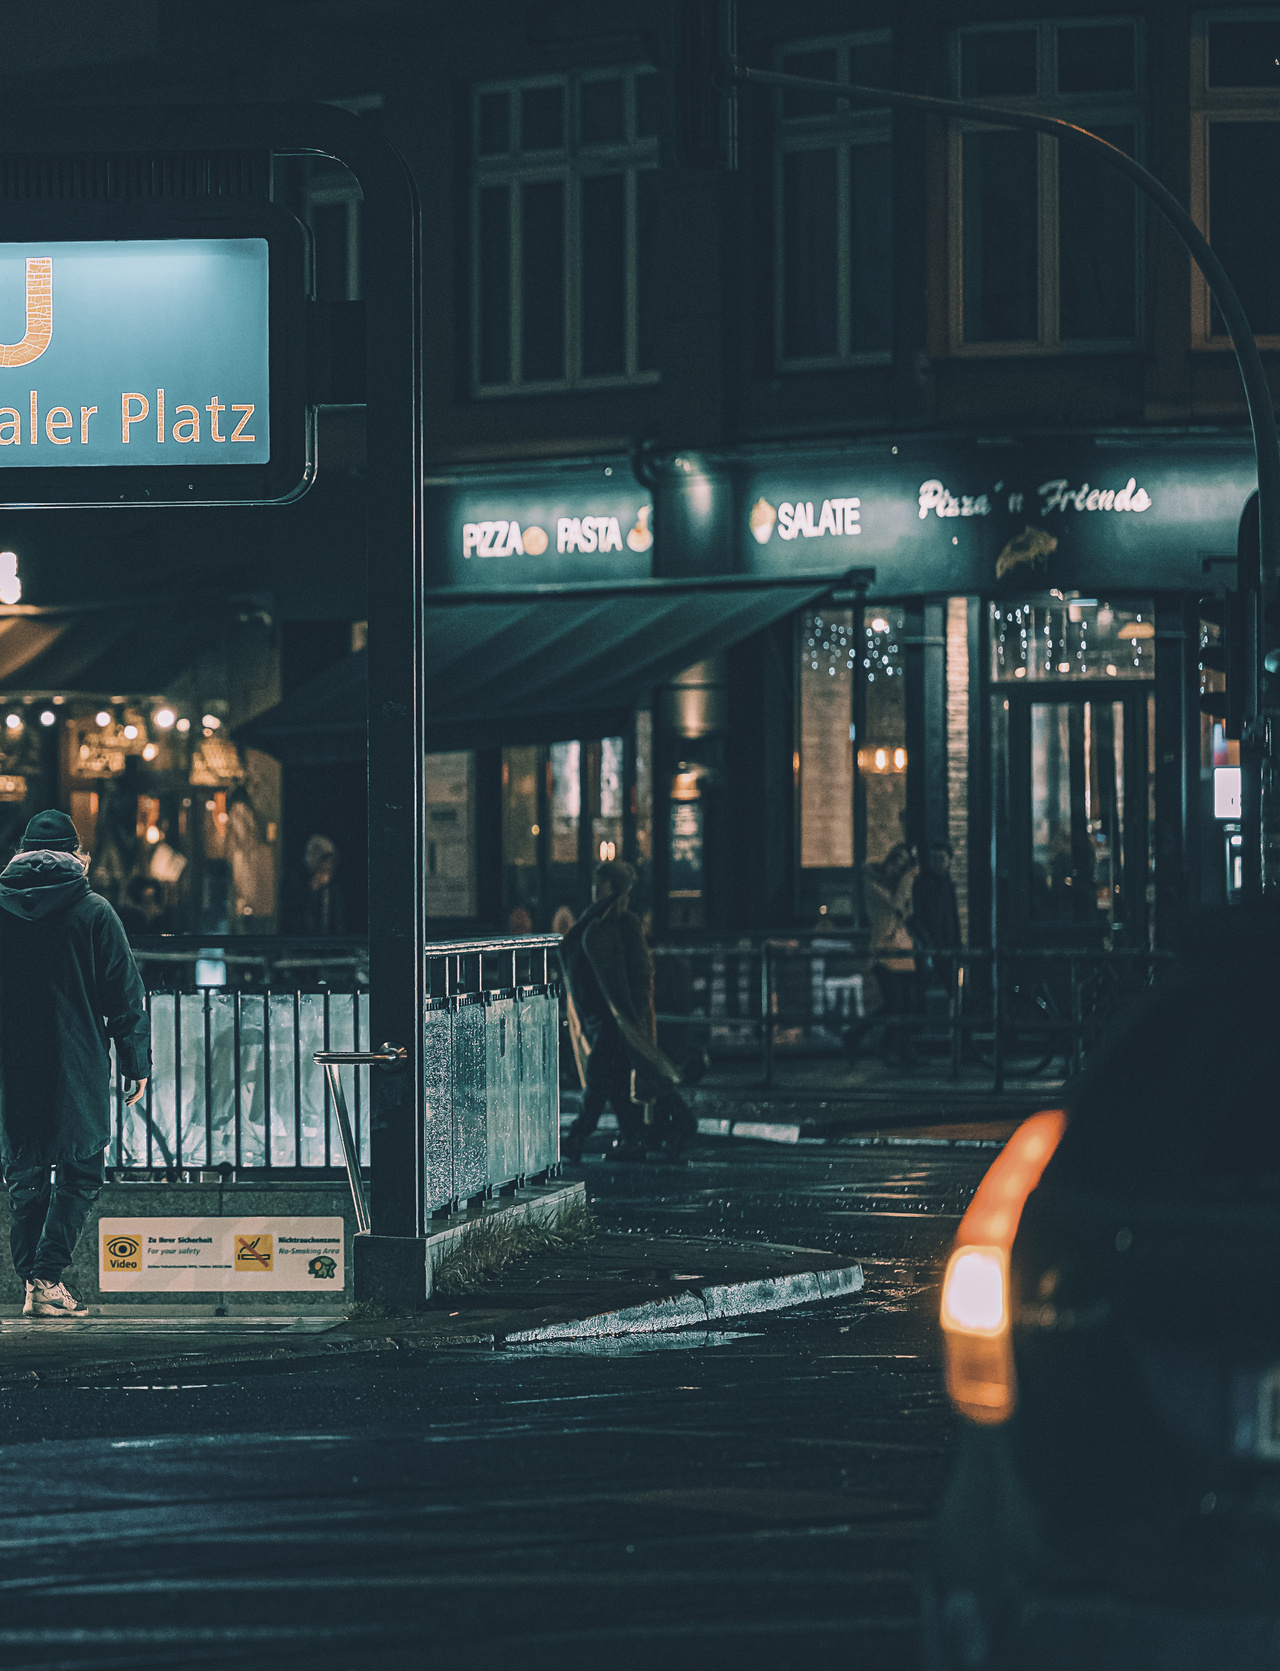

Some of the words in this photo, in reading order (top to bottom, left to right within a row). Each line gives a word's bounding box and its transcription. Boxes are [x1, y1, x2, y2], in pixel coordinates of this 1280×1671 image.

[120, 387, 256, 445] Platz
[919, 478, 992, 519] Pizza
[1037, 477, 1152, 516] Friends
[556, 515, 622, 553] PASTA
[777, 497, 862, 541] SALATE
[462, 520, 525, 559] PIZZA
[158, 1236, 177, 1244] Ihrer
[178, 1236, 213, 1244] Sicherheit
[160, 1248, 177, 1256] your
[178, 1247, 201, 1256] safety
[278, 1247, 322, 1255] No-Smoking
[109, 1259, 138, 1269] Video
